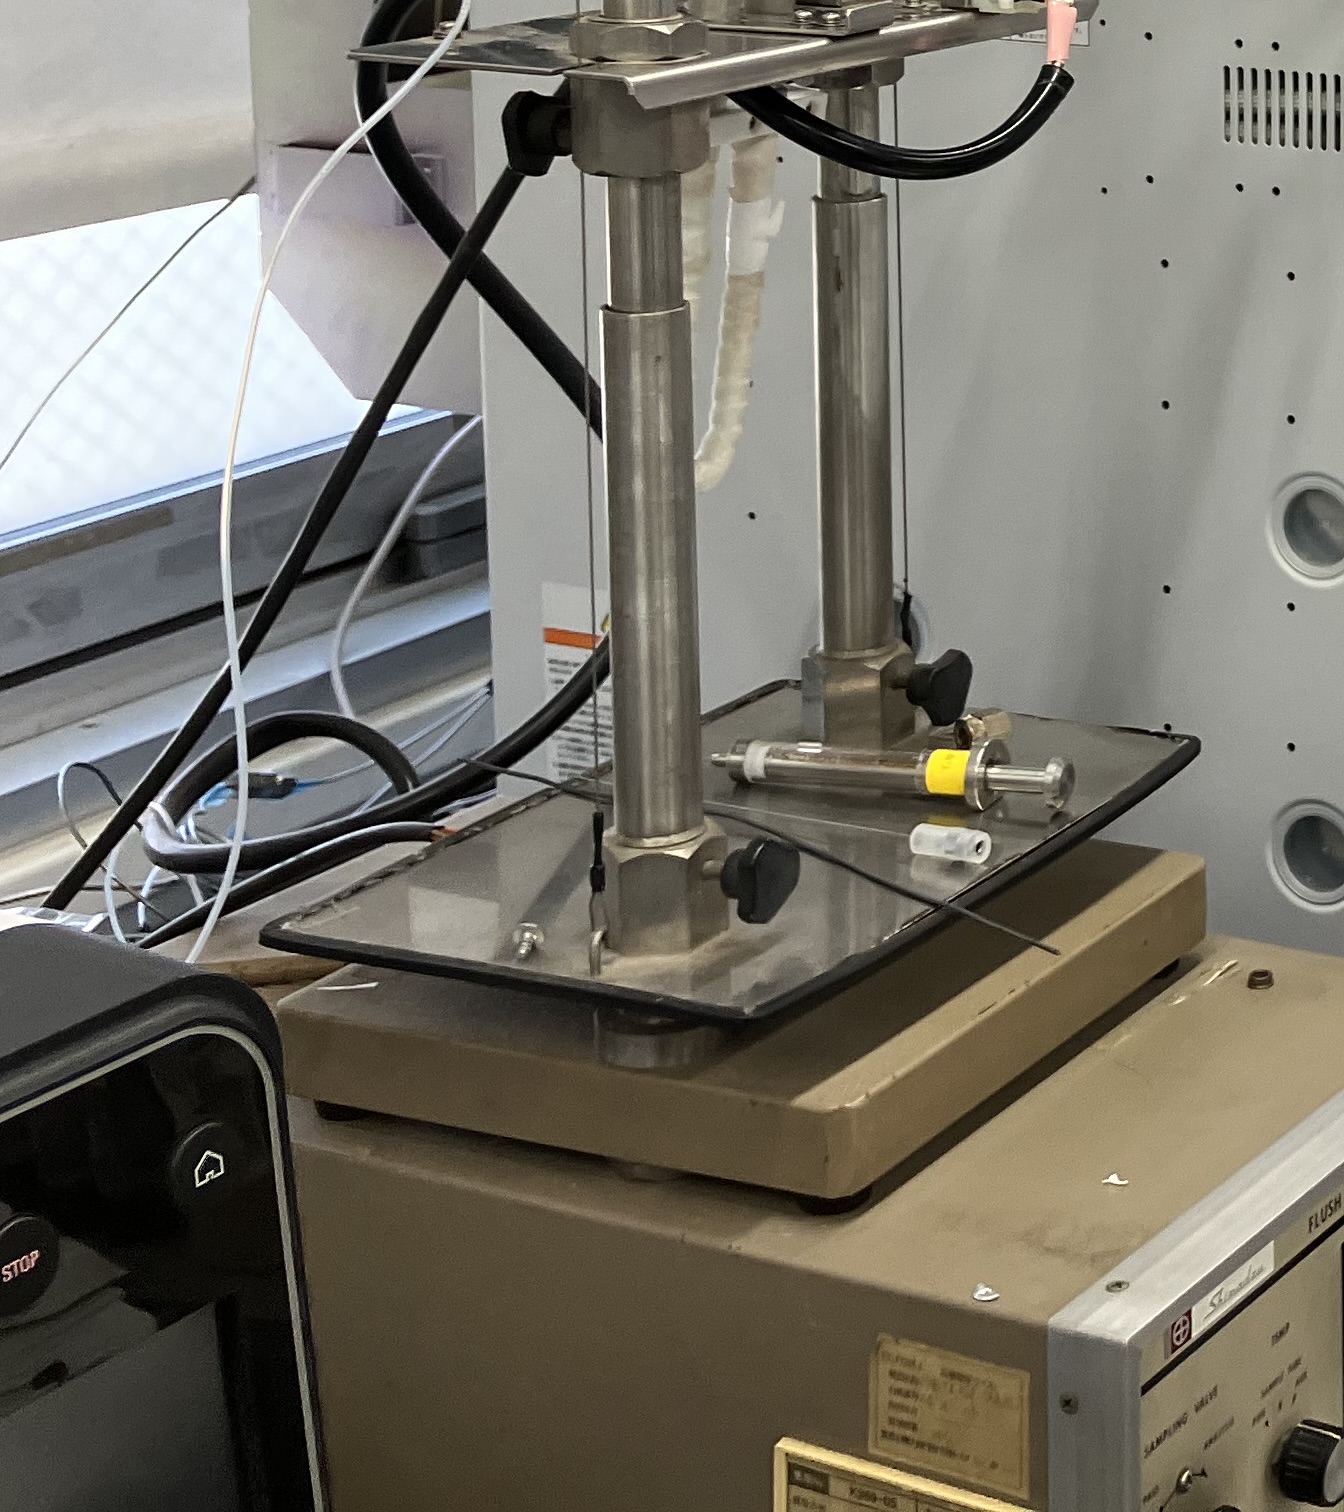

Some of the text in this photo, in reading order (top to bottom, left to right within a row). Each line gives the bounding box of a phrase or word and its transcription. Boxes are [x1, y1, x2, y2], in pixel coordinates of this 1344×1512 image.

[1308, 1194, 1342, 1234] FLUSH
[1, 1249, 40, 1282] STOP
[1144, 1385, 1218, 1459] SAMPLING VALVE
